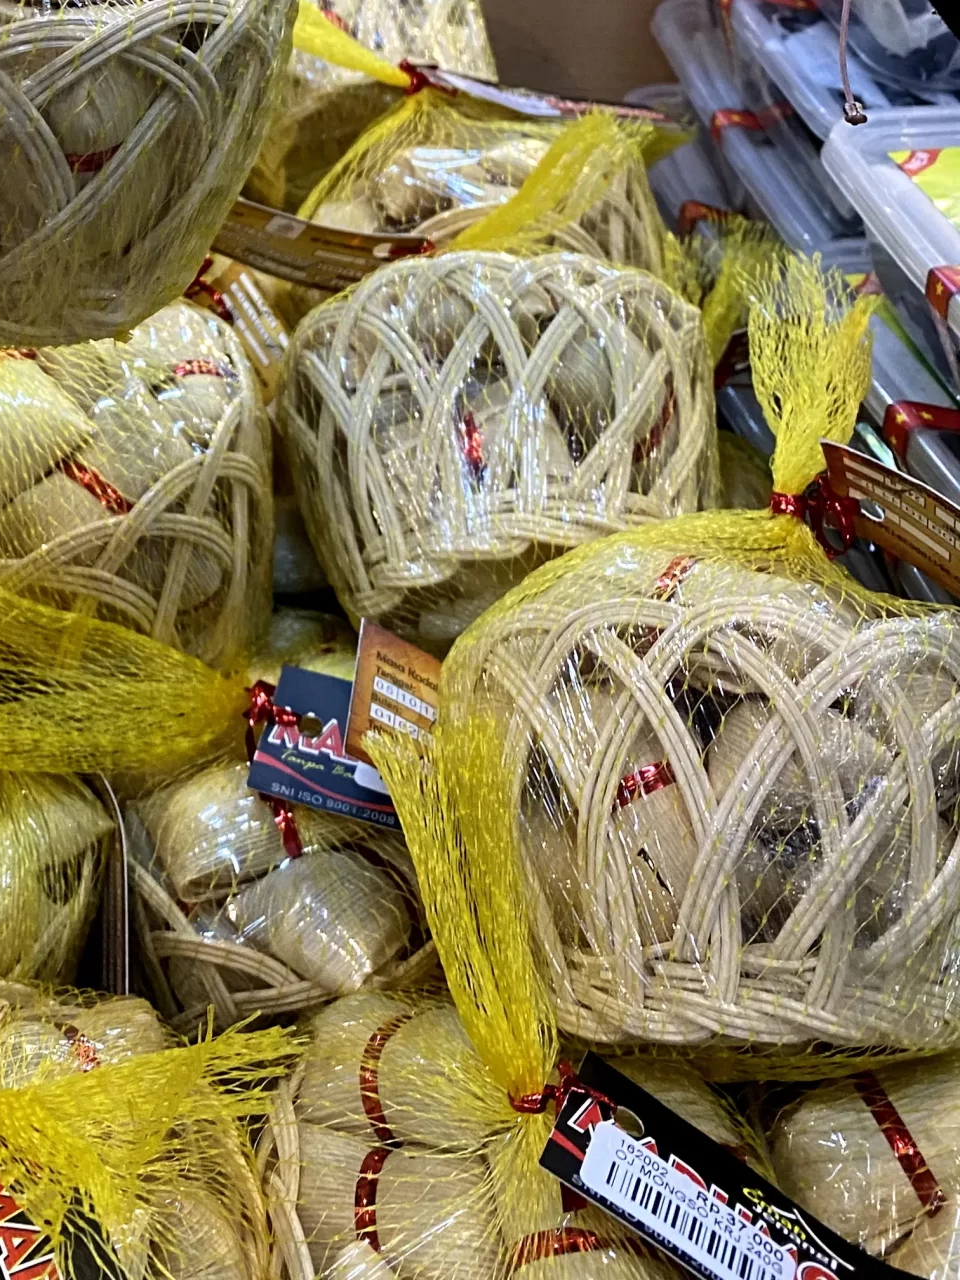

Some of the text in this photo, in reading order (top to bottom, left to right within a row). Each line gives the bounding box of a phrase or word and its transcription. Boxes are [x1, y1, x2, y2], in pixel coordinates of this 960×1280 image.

[375, 651, 406, 674] Masa
[399, 692, 418, 708] 10
[373, 709, 394, 724] 01
[281, 747, 326, 771] Tanpa
[270, 782, 396, 826] SNI ISO 9001:2008
[613, 1148, 637, 1168] OJ
[638, 1165, 711, 1220] MONGSO
[711, 1218, 743, 1244] KRJ
[744, 1242, 786, 1276] 240G
[617, 1137, 670, 1178] 162002
[693, 1190, 787, 1263] Rp.37.000
